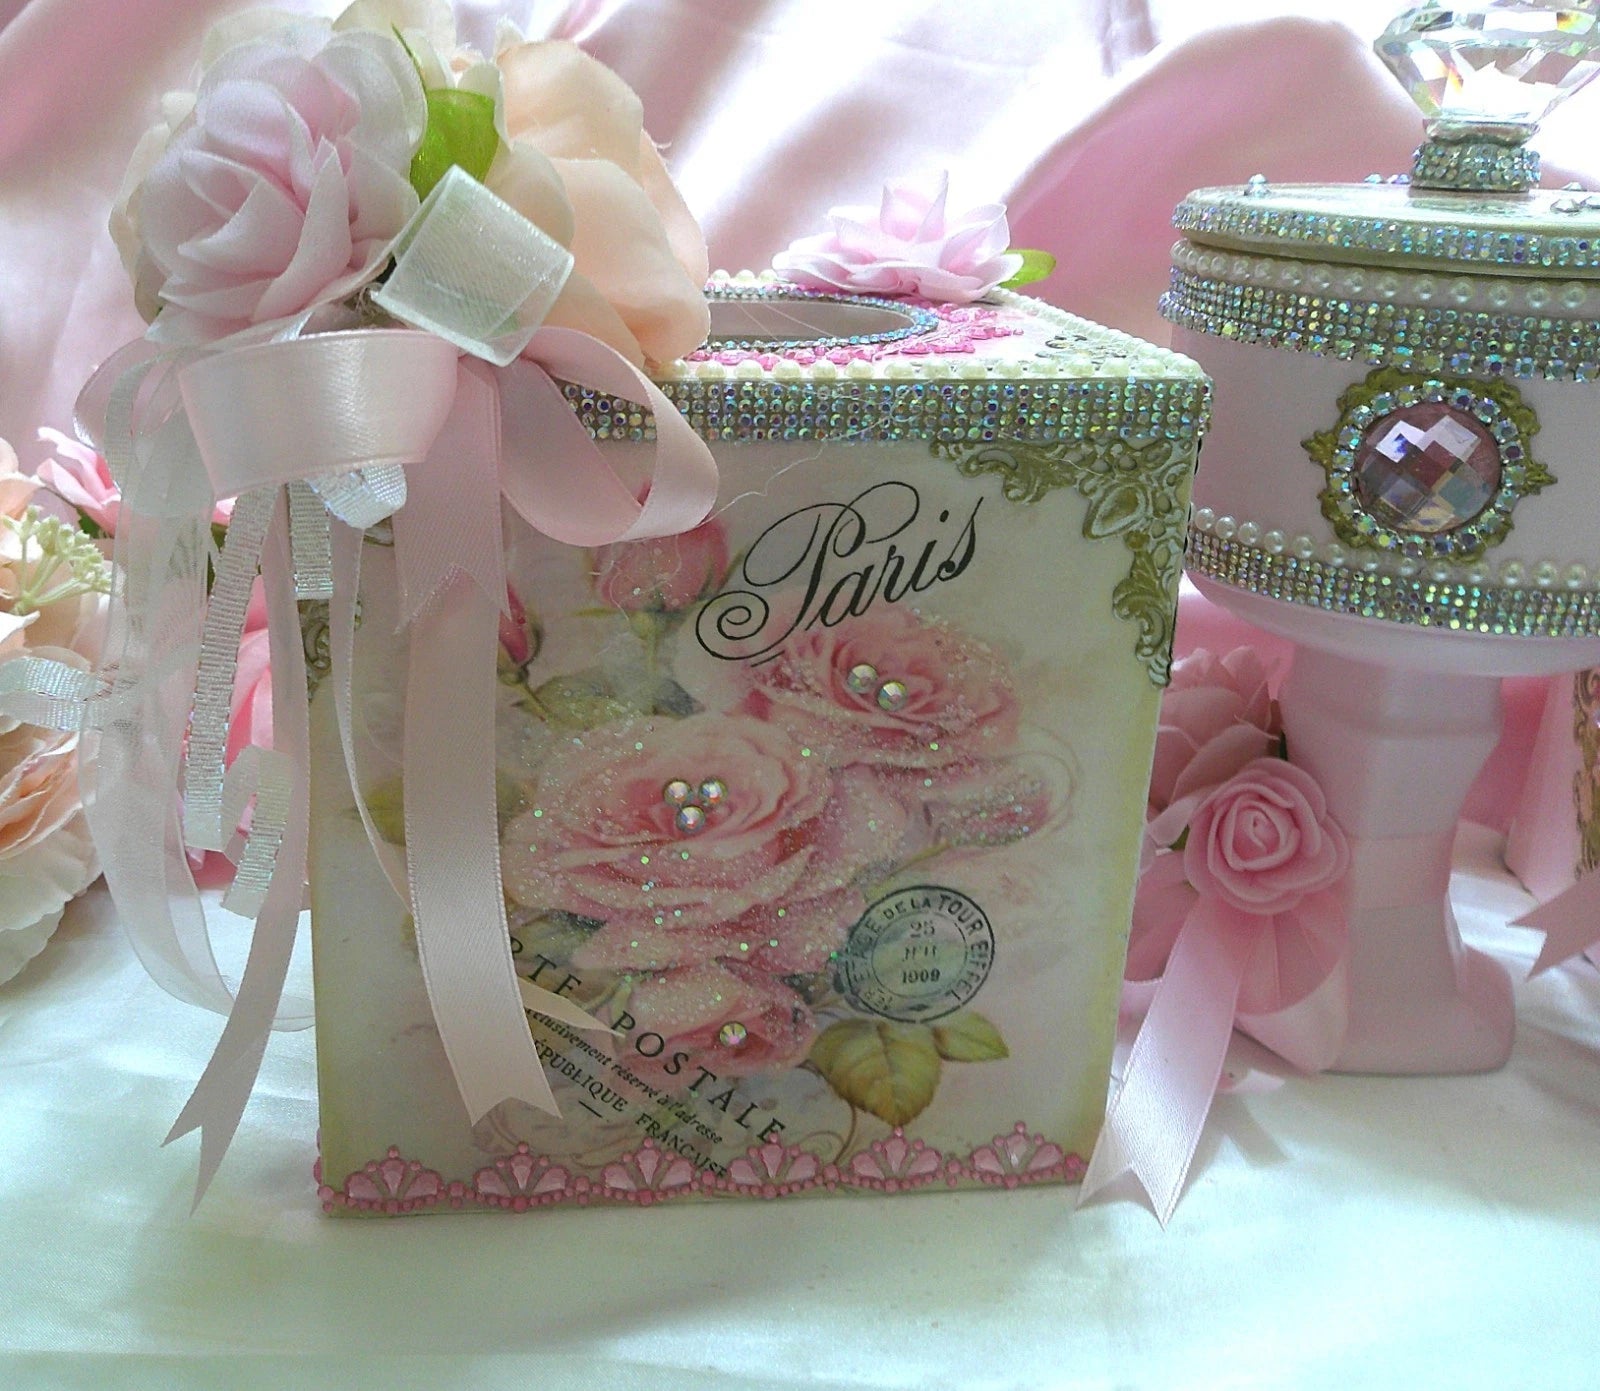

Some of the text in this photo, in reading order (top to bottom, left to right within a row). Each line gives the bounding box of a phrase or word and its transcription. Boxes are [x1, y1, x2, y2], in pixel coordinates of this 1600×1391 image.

[695, 481, 984, 664] Paris
[882, 900, 907, 921] DE
[910, 896, 932, 911] LA
[938, 893, 984, 937] TOUR
[944, 939, 990, 1001] EIFFEL
[509, 935, 787, 1144] RTE POSTALE
[524, 1007, 613, 1067] clusivement
[532, 1037, 629, 1113] ÉPUBLIQUE
